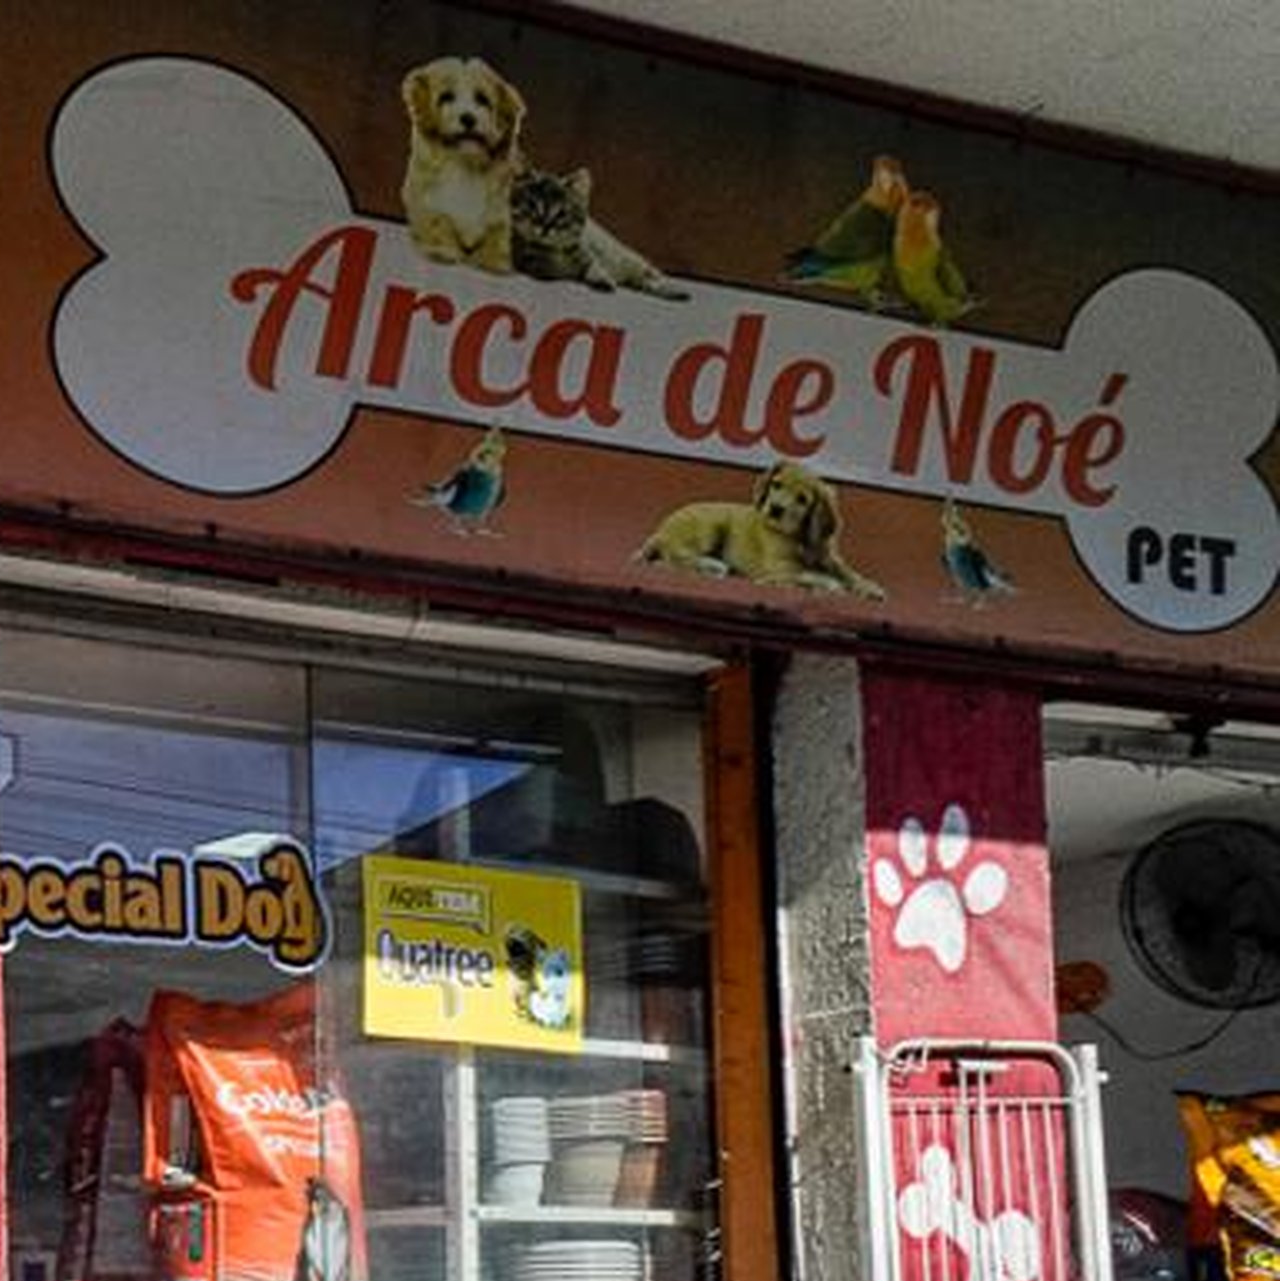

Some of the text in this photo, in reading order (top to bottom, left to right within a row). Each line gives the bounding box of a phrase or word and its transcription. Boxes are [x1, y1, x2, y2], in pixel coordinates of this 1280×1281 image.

[230, 222, 1132, 511] Arca de Noé
[1125, 524, 1238, 598] PET
[195, 844, 324, 966] Dog
